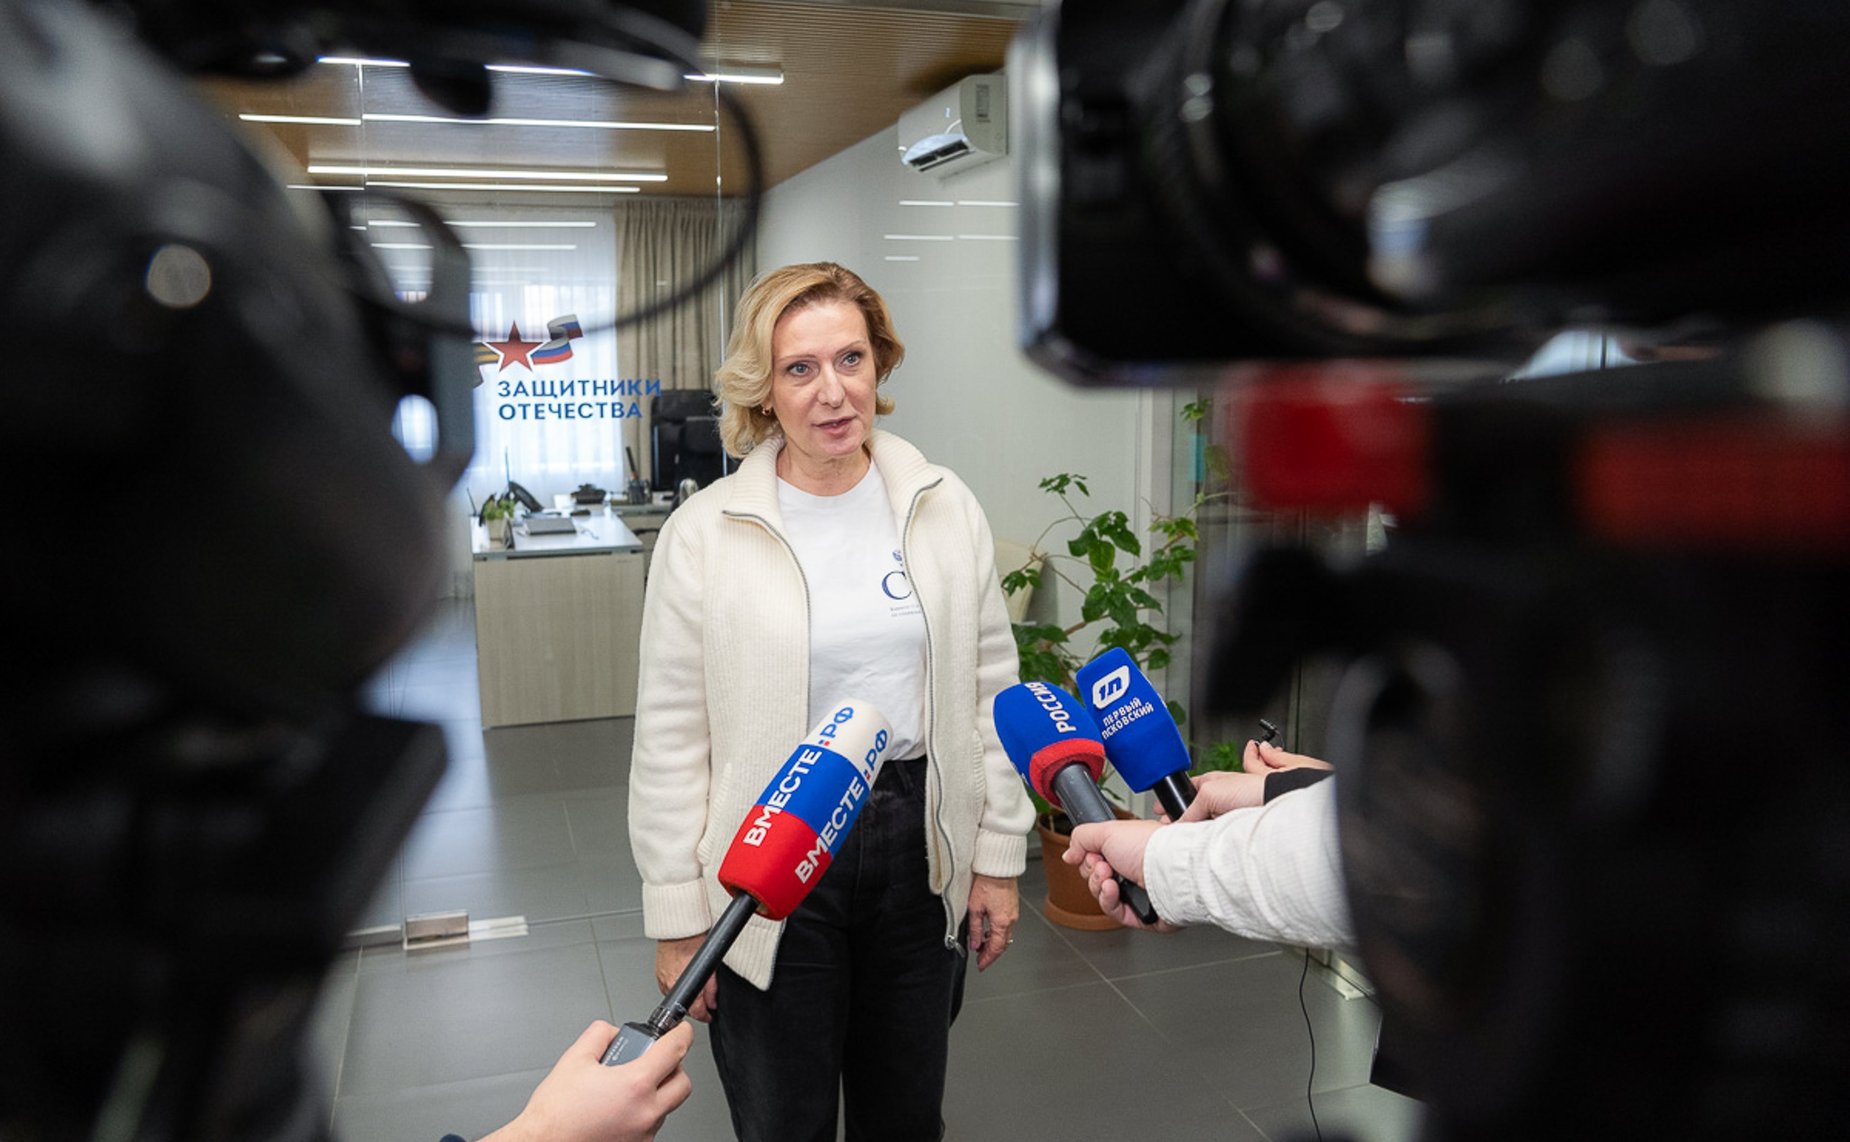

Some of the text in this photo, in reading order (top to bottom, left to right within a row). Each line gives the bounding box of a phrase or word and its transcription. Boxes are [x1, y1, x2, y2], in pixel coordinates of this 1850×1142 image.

[498, 379, 661, 398] ЗАЩИТНИКИ
[499, 402, 642, 420] ОТЕЧЕСТВА
[1101, 702, 1154, 740] ПСКОВСКИЙ
[1103, 696, 1142, 727] ПЕРВЫЙ
